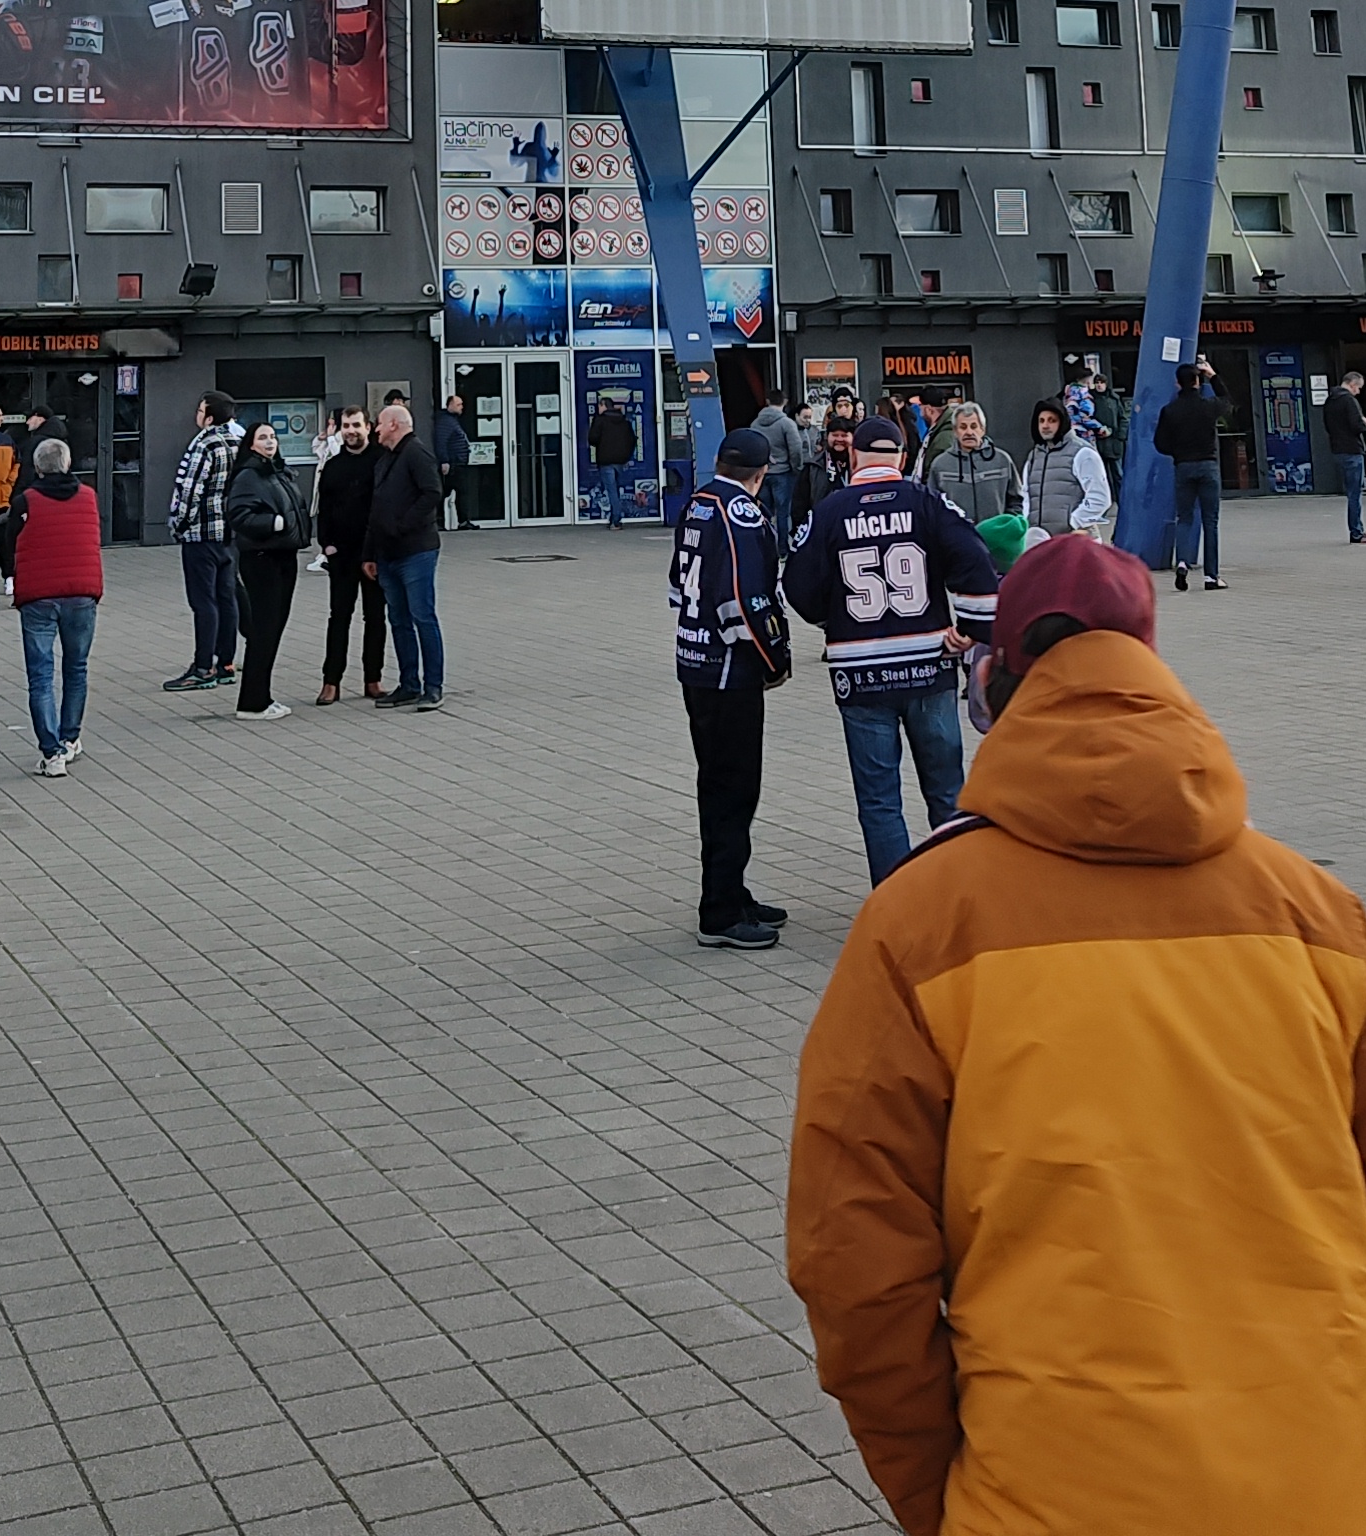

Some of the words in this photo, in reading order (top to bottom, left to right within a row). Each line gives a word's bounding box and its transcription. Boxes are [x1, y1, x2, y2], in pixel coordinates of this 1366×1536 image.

[33, 85, 106, 105] CIEĽ
[580, 300, 612, 315] fan
[1085, 320, 1129, 337] VSTUP
[1132, 321, 1142, 337] A
[1215, 320, 1255, 334] TICKETS
[43, 333, 100, 351] TICKETS
[587, 363, 611, 375] STEEL
[614, 363, 641, 374] ARENA
[885, 350, 972, 376] POKLADŇA
[588, 405, 596, 415] B
[635, 404, 643, 414] A
[844, 511, 913, 541] VÁCLAV
[839, 542, 931, 623] 59
[881, 667, 909, 682] Steel
